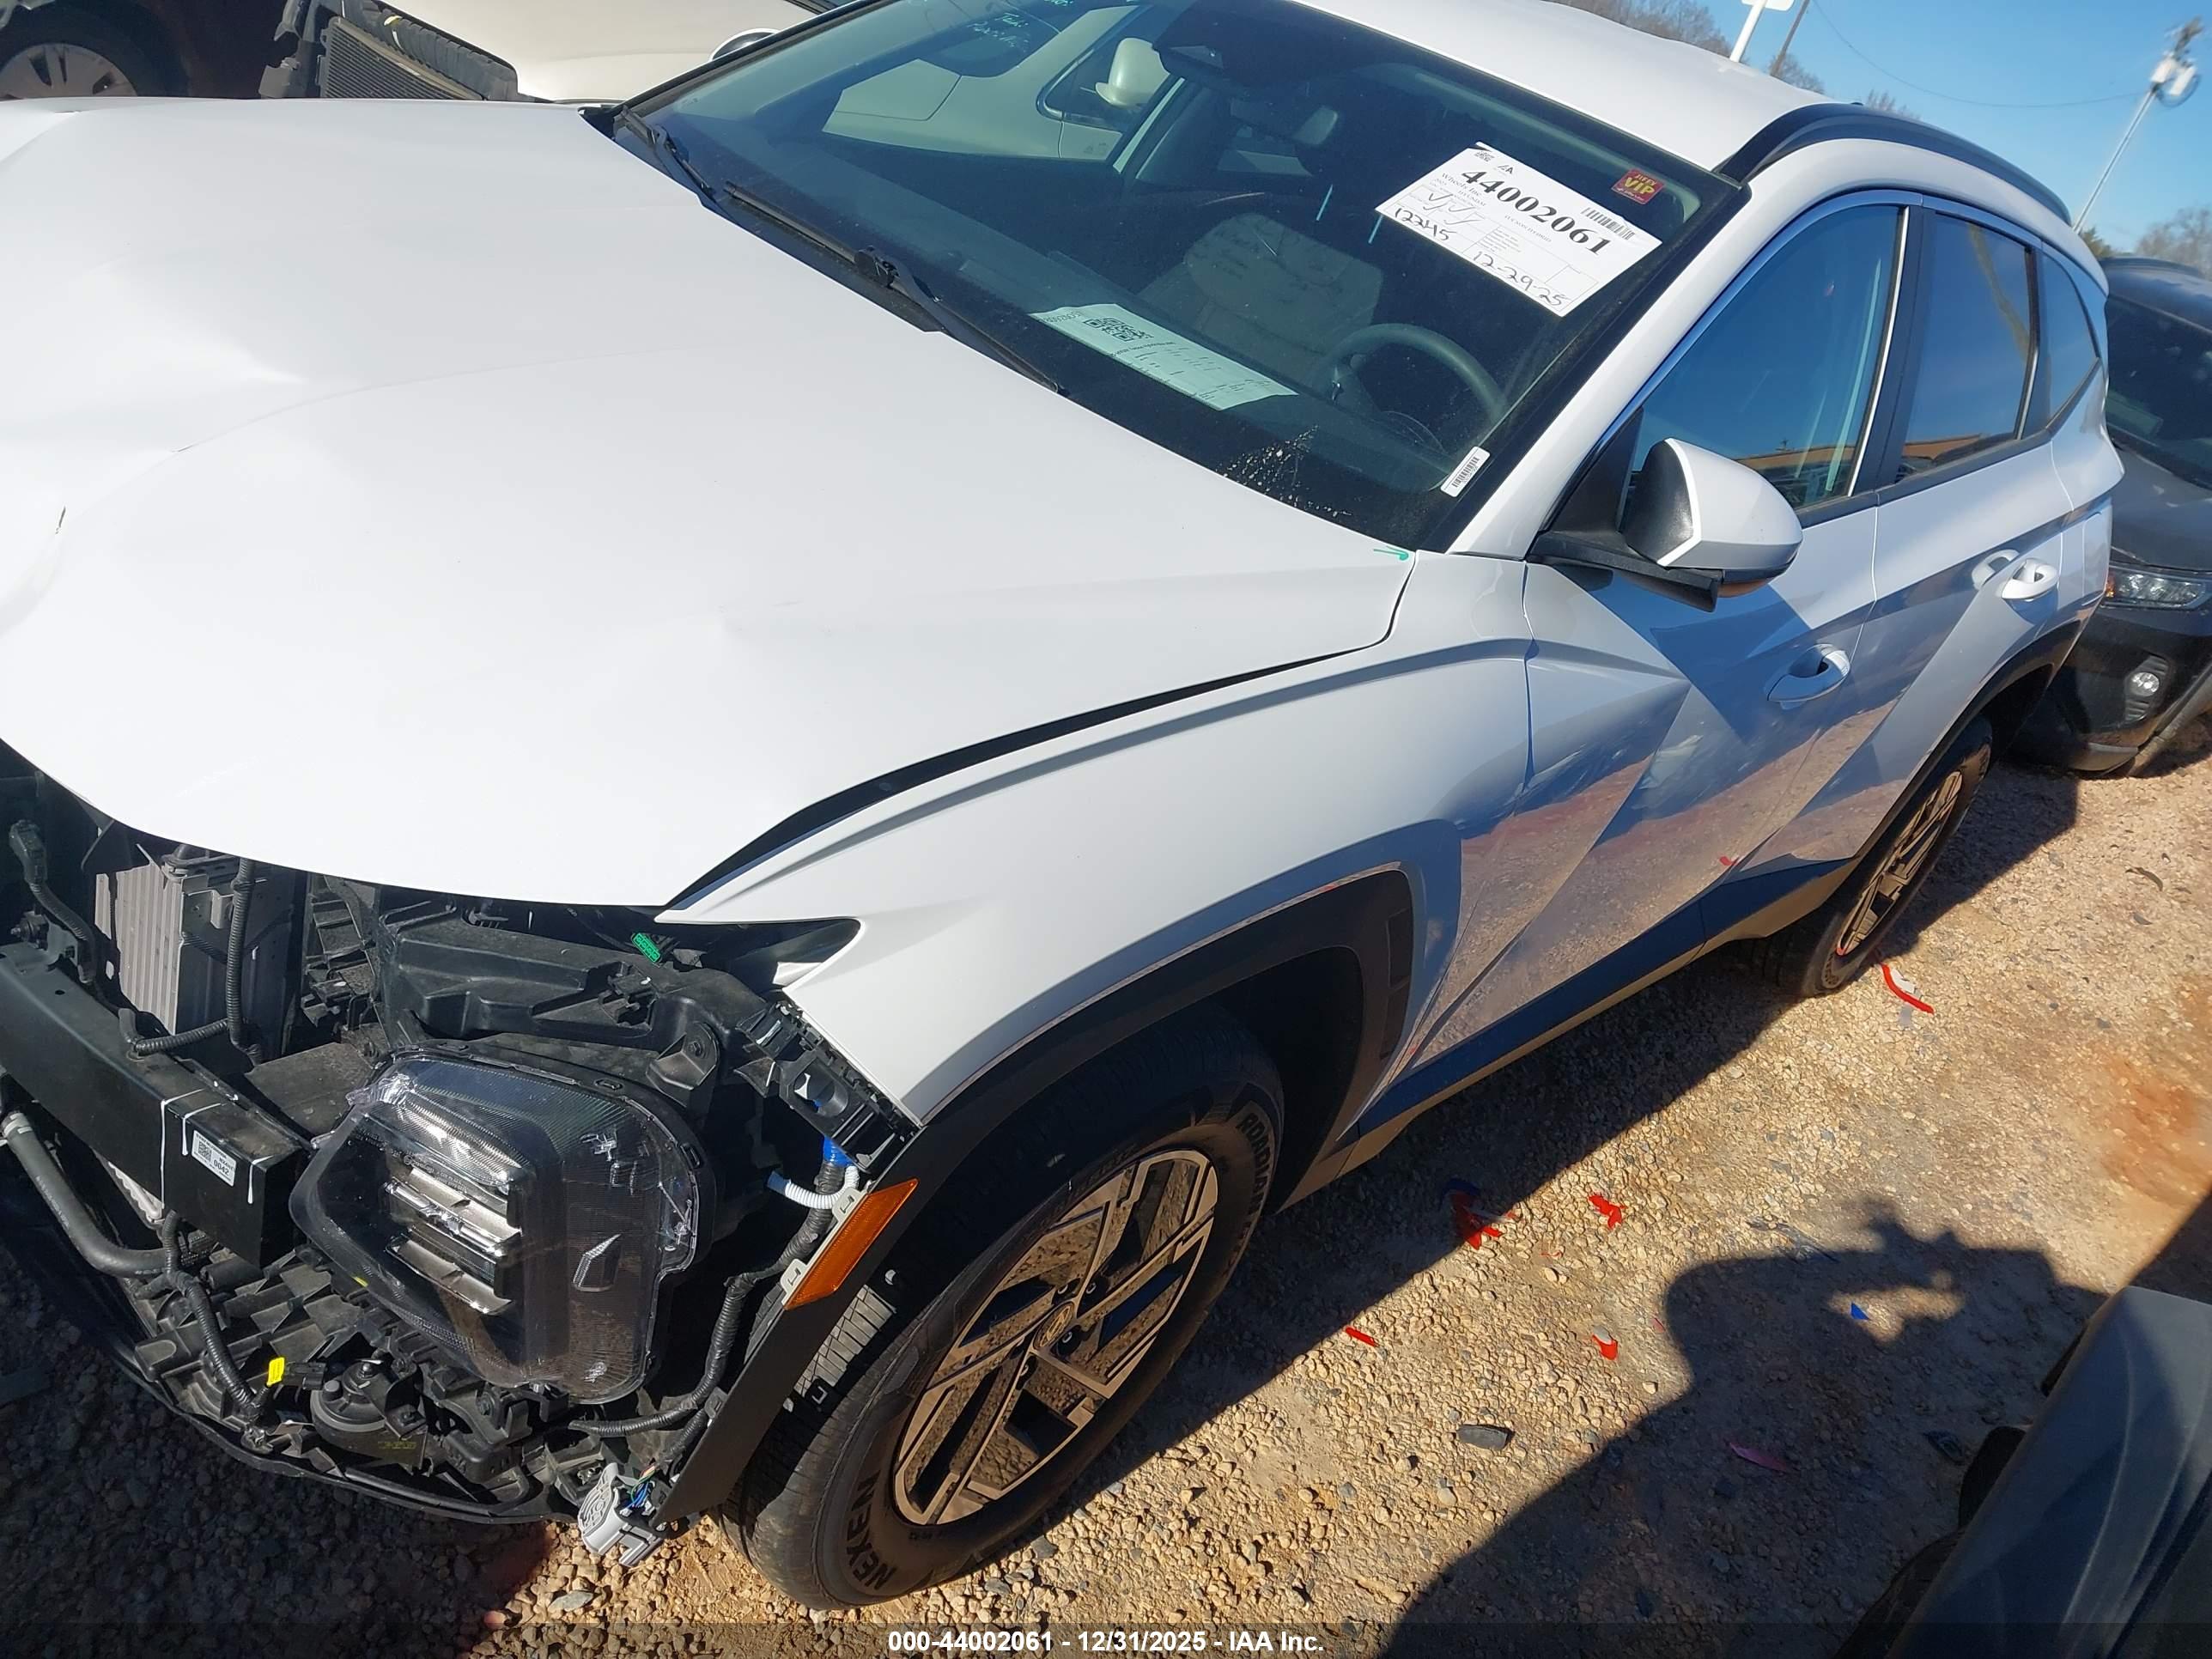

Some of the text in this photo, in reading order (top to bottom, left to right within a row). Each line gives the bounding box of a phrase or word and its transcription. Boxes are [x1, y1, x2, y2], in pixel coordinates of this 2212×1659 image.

[1462, 171, 1612, 256] 44002061
[1625, 177, 1656, 195] VIP
[1473, 251, 1572, 306] 12-29-25
[213, 1159, 230, 1176] 0042
[846, 1469, 897, 1590] NEXEN
